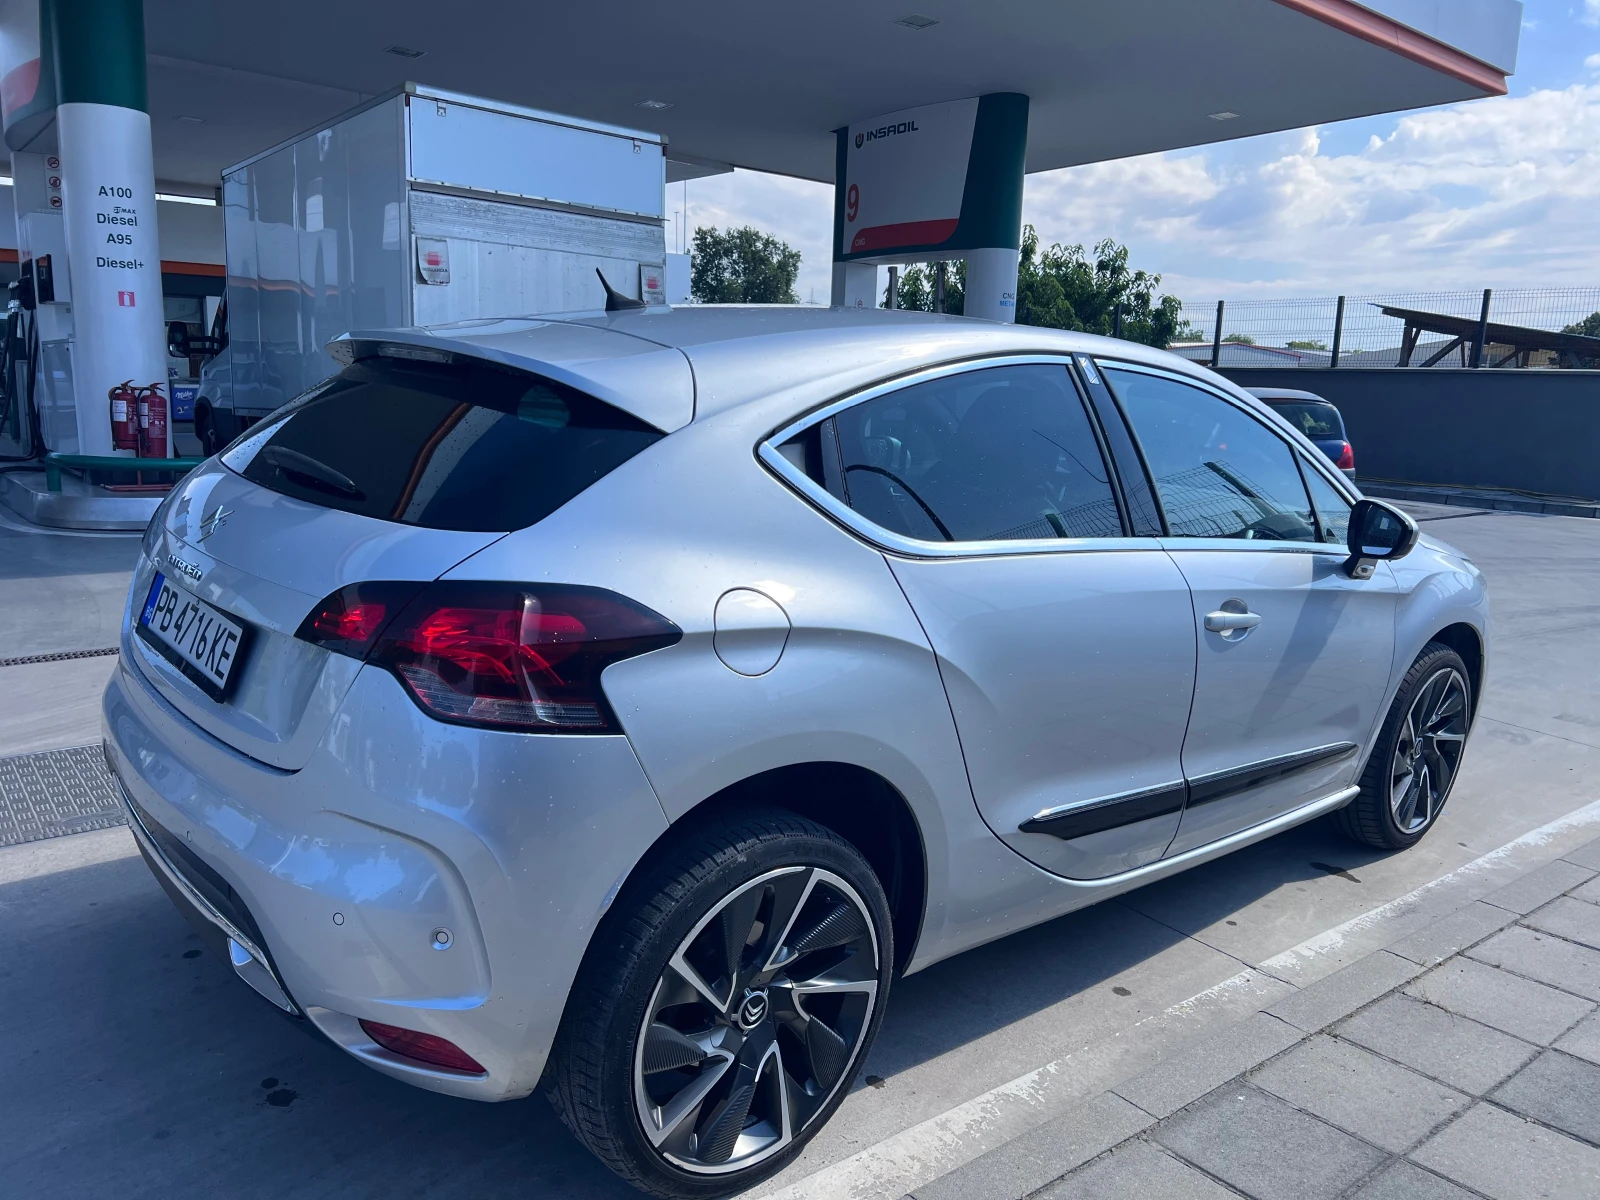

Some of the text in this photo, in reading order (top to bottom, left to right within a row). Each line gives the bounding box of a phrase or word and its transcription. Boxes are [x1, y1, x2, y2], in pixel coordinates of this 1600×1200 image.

[866, 120, 919, 142] INSAOIL
[98, 185, 132, 199] A100
[846, 183, 860, 223] 9
[96, 213, 138, 227] Diesel
[106, 233, 132, 245] A95
[854, 238, 866, 247] CNG
[96, 257, 145, 270] Diesel+
[151, 585, 238, 681] PB 4716 KE
